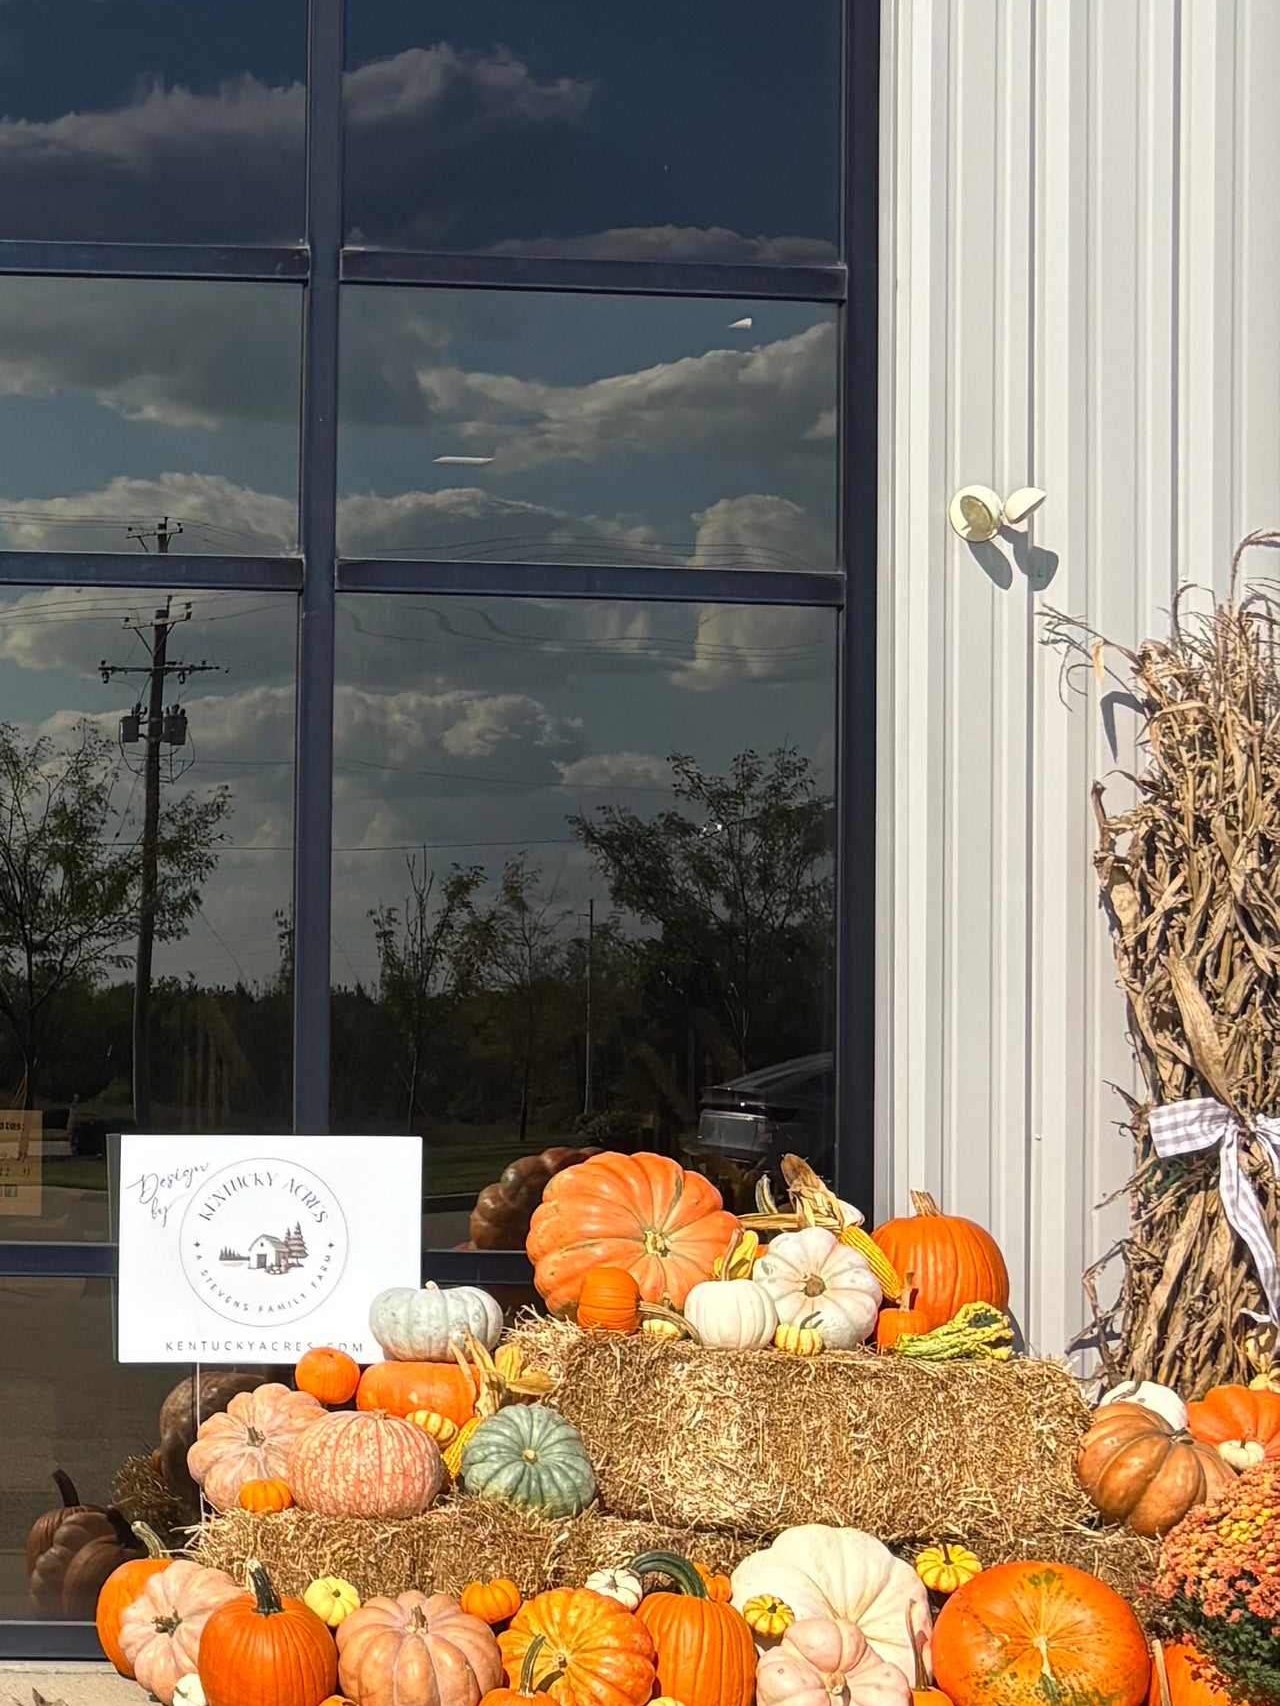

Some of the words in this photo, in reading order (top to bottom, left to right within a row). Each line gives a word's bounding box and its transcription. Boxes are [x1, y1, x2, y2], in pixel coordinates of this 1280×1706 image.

[126, 1162, 209, 1204] Design
[198, 1172, 278, 1222] KENTUCKY
[282, 1178, 329, 1224] ACRES
[151, 1196, 190, 1228] by
[200, 1268, 249, 1312] STEVENS
[258, 1292, 307, 1313] FAMILY
[310, 1254, 332, 1289] FARM
[165, 1340, 364, 1353] KENTUCKYACRESOM
